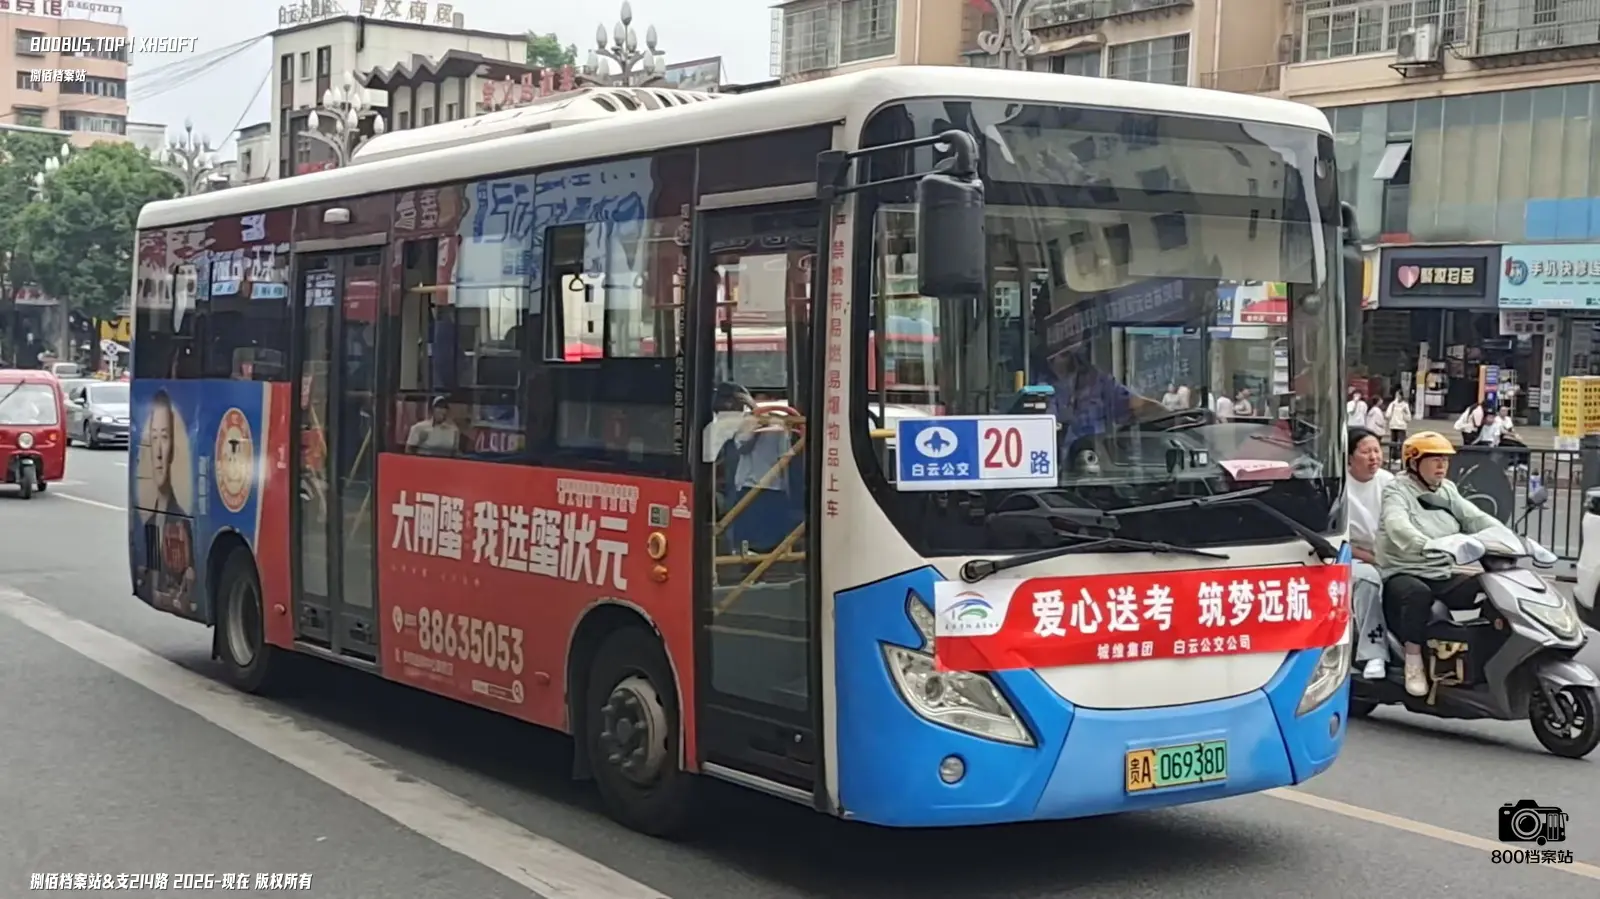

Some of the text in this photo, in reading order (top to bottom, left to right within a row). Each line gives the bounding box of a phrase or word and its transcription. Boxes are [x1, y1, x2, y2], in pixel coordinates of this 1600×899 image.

[912, 463, 970, 477] 白云公交
[392, 490, 465, 560] 大闸蟹
[472, 501, 629, 591] 我选蟹状元
[1032, 584, 1175, 638] 爱心送考
[1197, 576, 1312, 635] 筑梦远航
[418, 606, 524, 675] 88635053
[1097, 635, 1252, 659] 城维集团 白云公交公司
